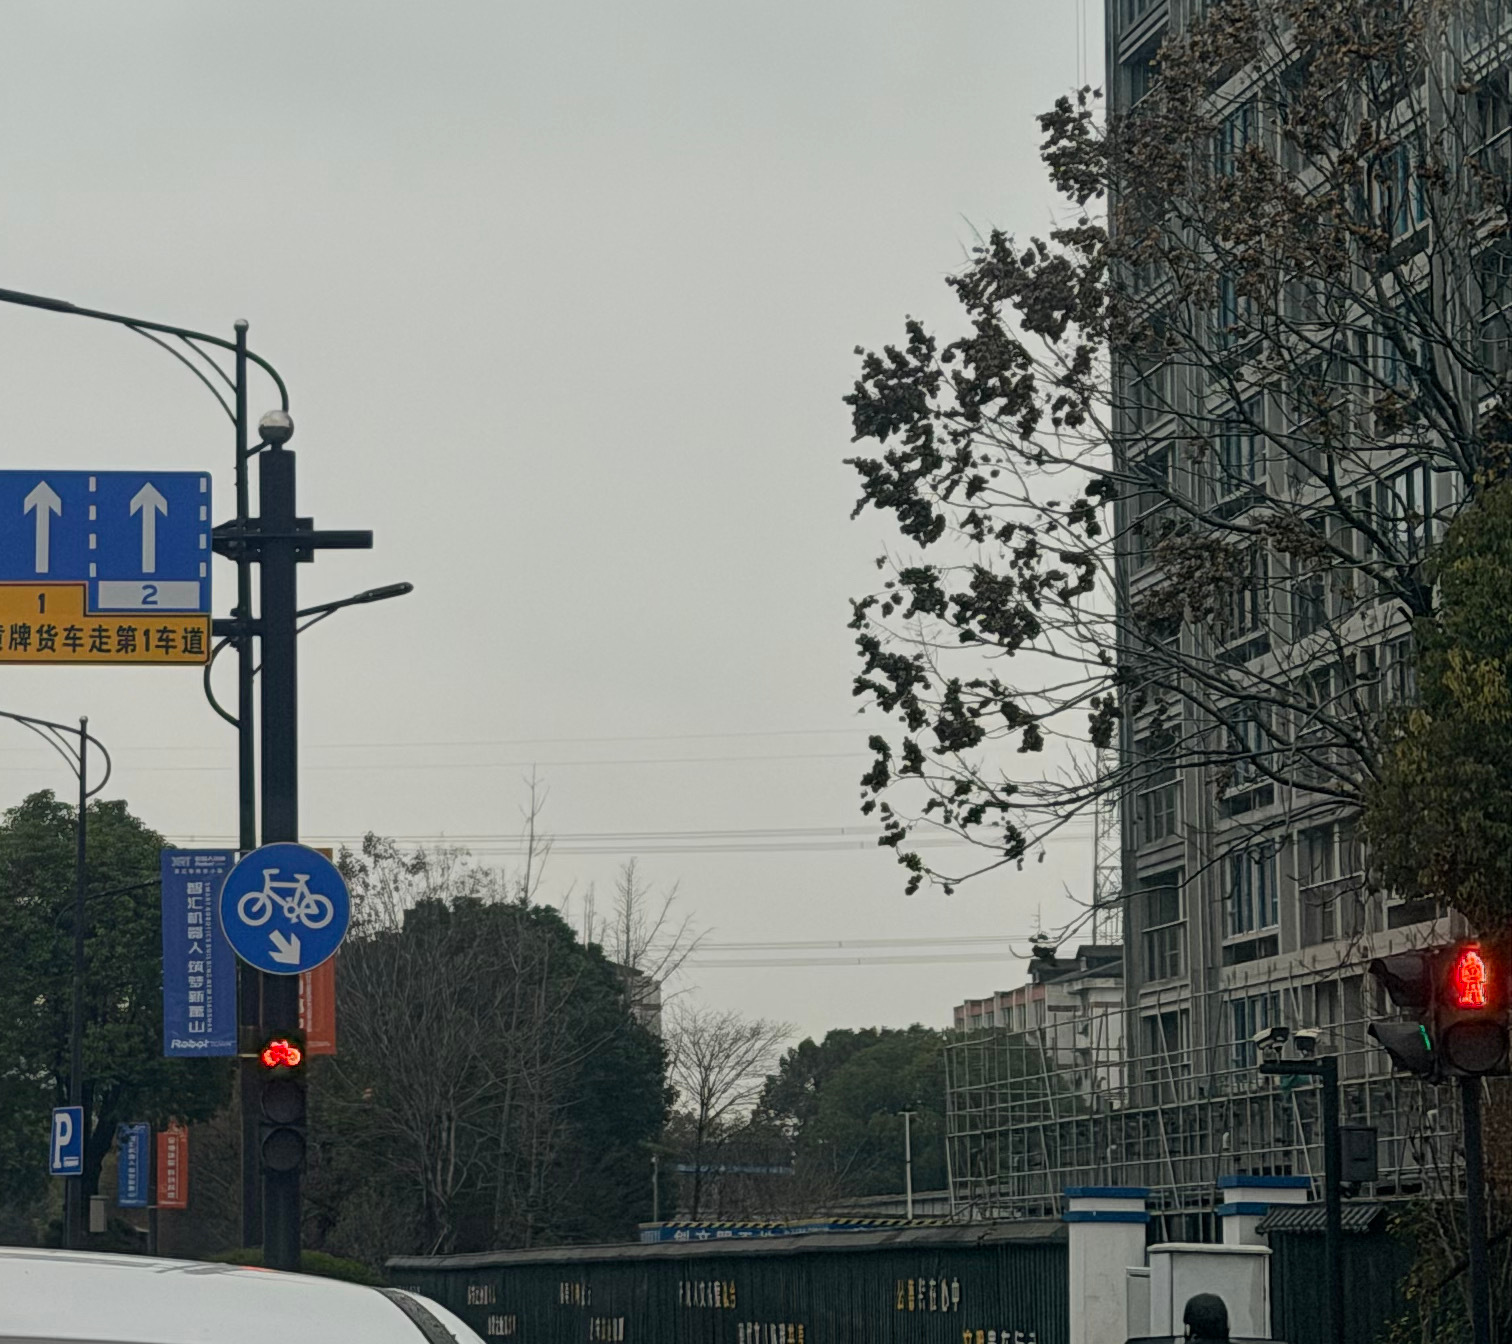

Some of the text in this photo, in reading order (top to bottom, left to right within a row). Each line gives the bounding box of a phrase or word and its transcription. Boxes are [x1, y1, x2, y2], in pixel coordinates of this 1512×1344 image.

[37, 593, 46, 614] 1
[141, 584, 158, 605] 2
[53, 1113, 73, 1169] P
